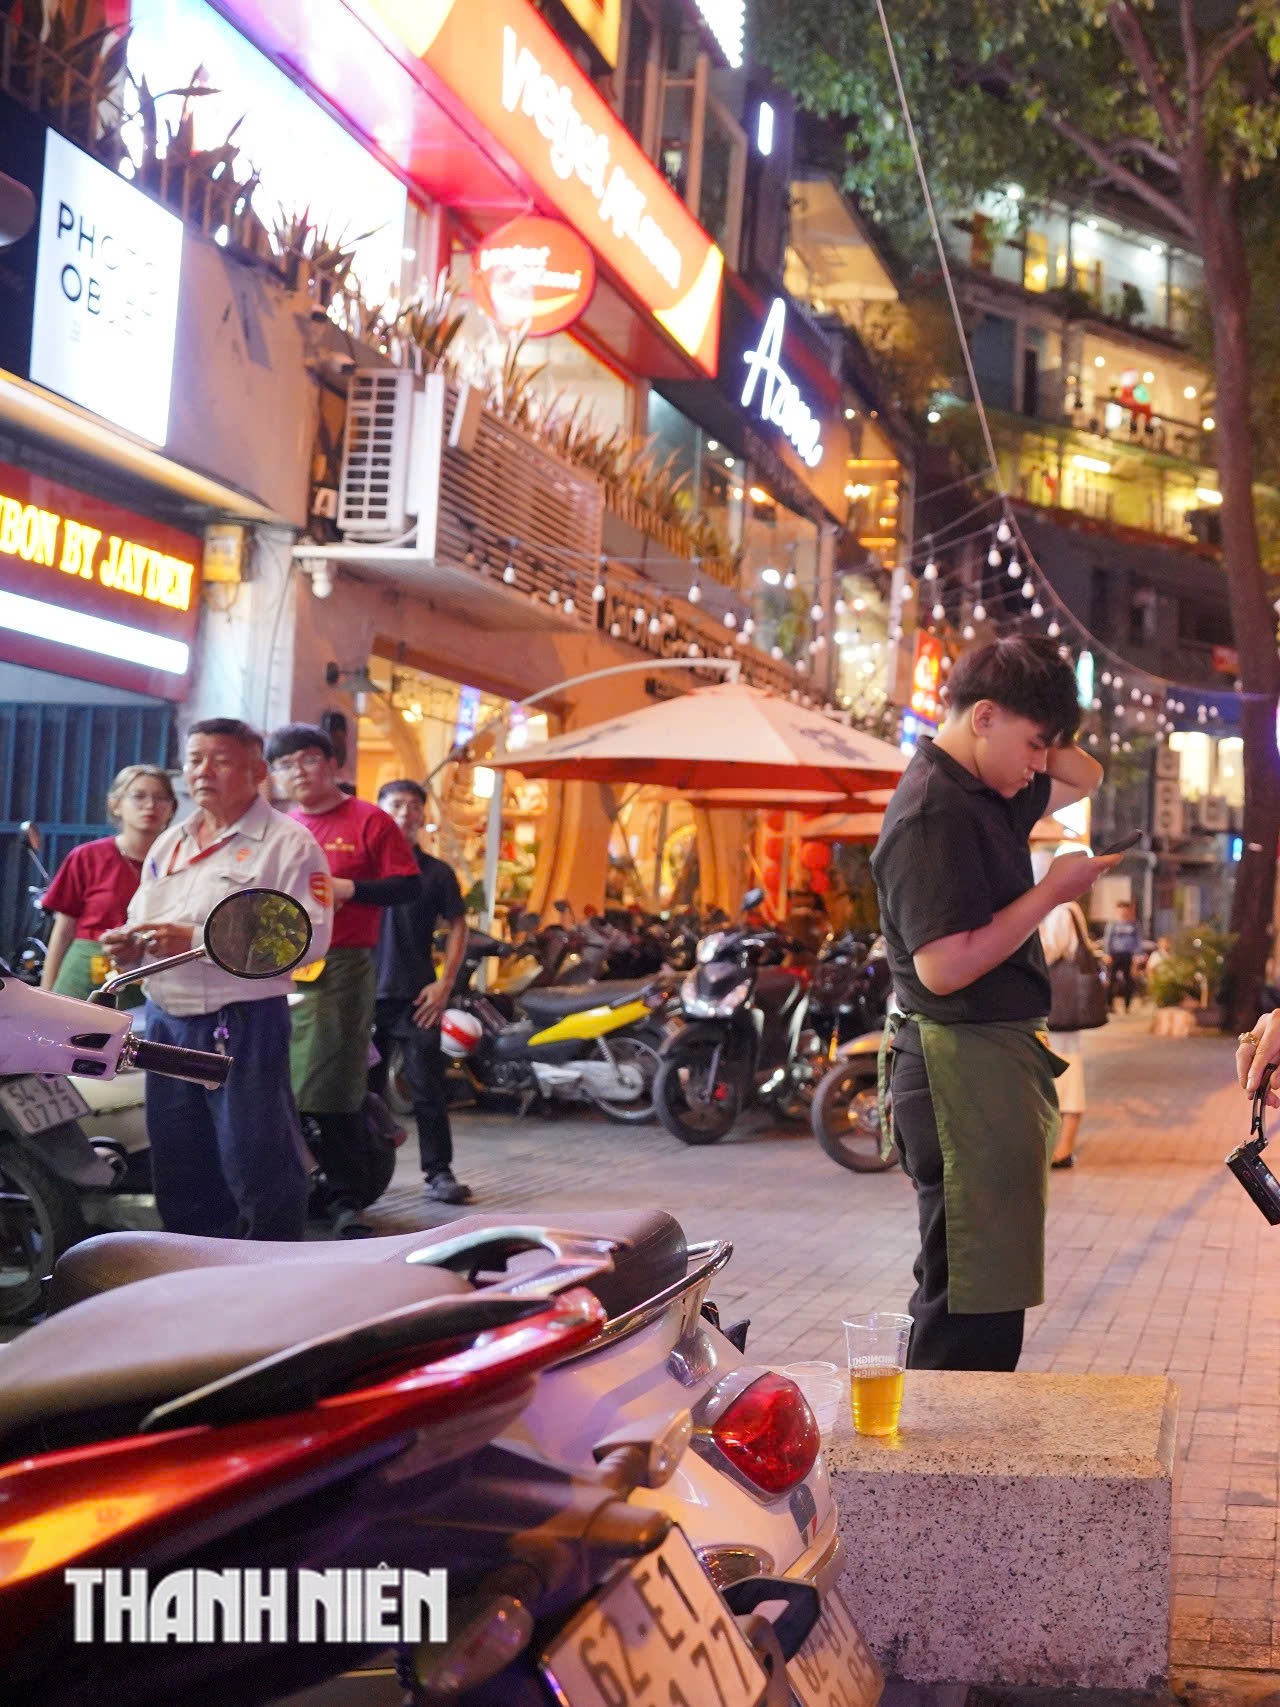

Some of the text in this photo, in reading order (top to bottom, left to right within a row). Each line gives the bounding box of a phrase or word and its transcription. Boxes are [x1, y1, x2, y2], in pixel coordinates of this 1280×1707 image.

[0, 494, 194, 612] BON BY JAYDEN
